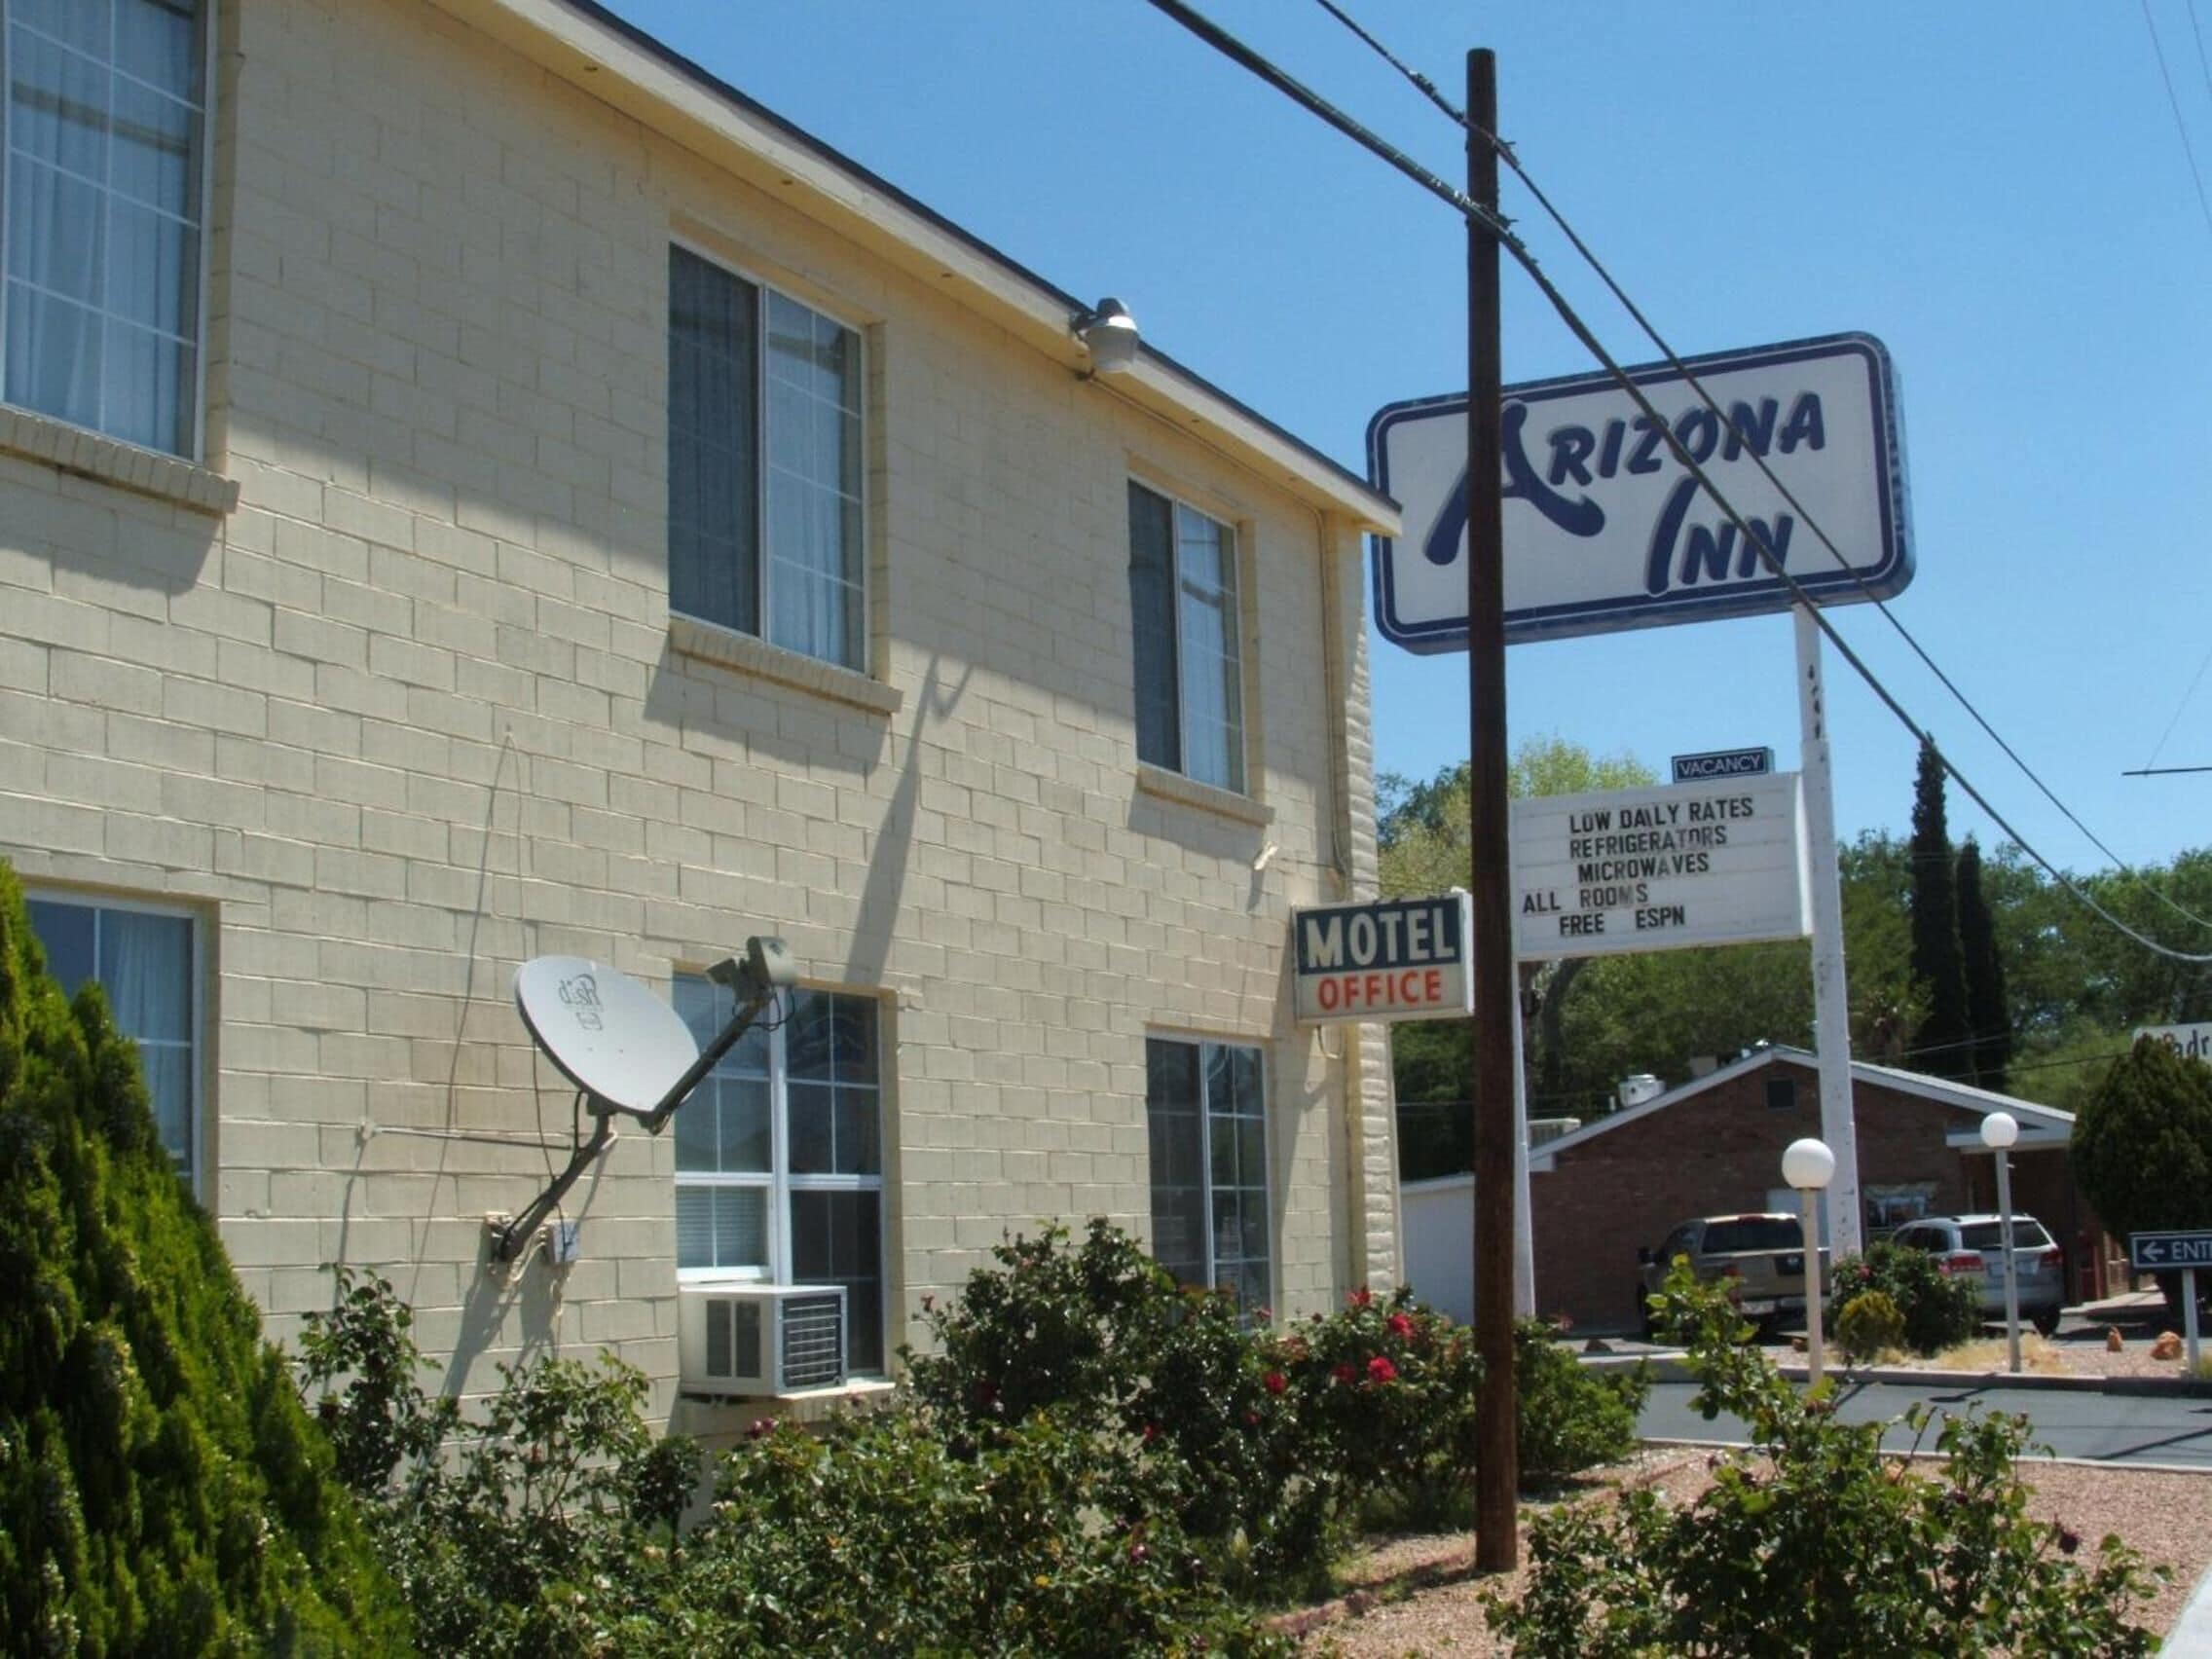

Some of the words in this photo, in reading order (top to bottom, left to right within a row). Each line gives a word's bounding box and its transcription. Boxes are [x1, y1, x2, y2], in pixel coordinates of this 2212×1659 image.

[1424, 391, 1826, 566] ARIZONA
[1644, 475, 1794, 597] INN
[1680, 754, 1761, 777] VACANCY
[1569, 811, 1611, 834] LOW
[1689, 796, 1753, 823] RATES
[1577, 852, 1710, 884] MICROWAVES
[1523, 891, 1562, 914] ALL
[1559, 912, 1605, 936] FREE
[1635, 904, 1685, 929] ESPN
[1306, 906, 1456, 969] MOTEL
[1317, 970, 1442, 1012] OFFICE
[2171, 1240, 2212, 1260] ENT
